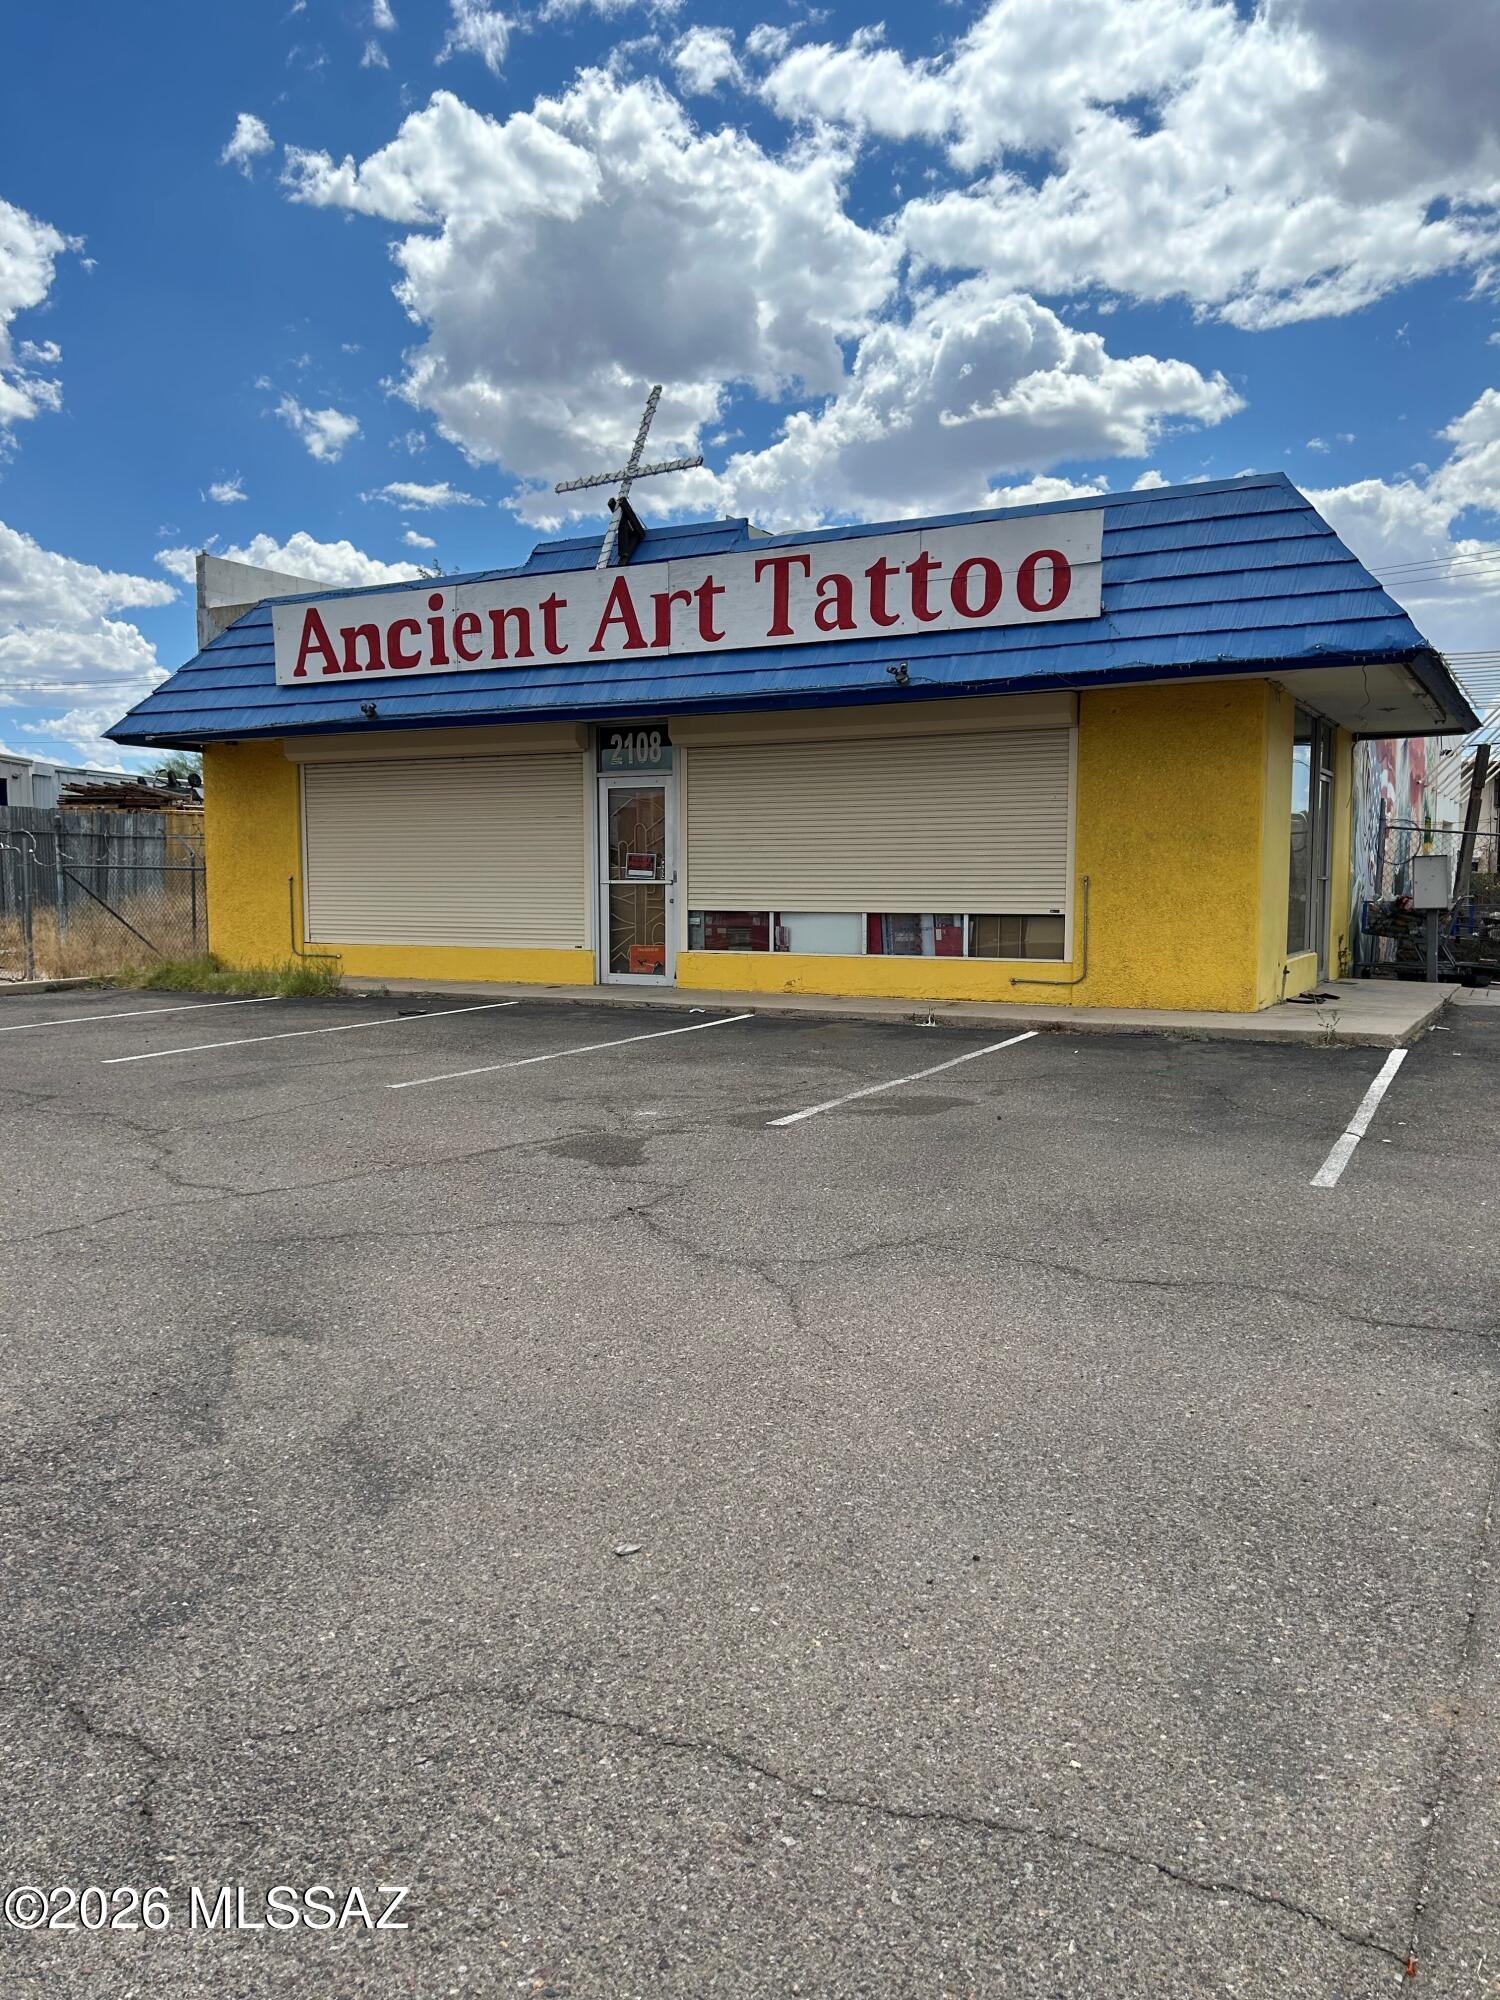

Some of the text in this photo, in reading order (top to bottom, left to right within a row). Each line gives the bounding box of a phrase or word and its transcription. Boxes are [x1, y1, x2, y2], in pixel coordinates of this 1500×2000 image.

[293, 549, 1072, 677] Ancient Art Tattoo
[610, 731, 662, 765] 2108
